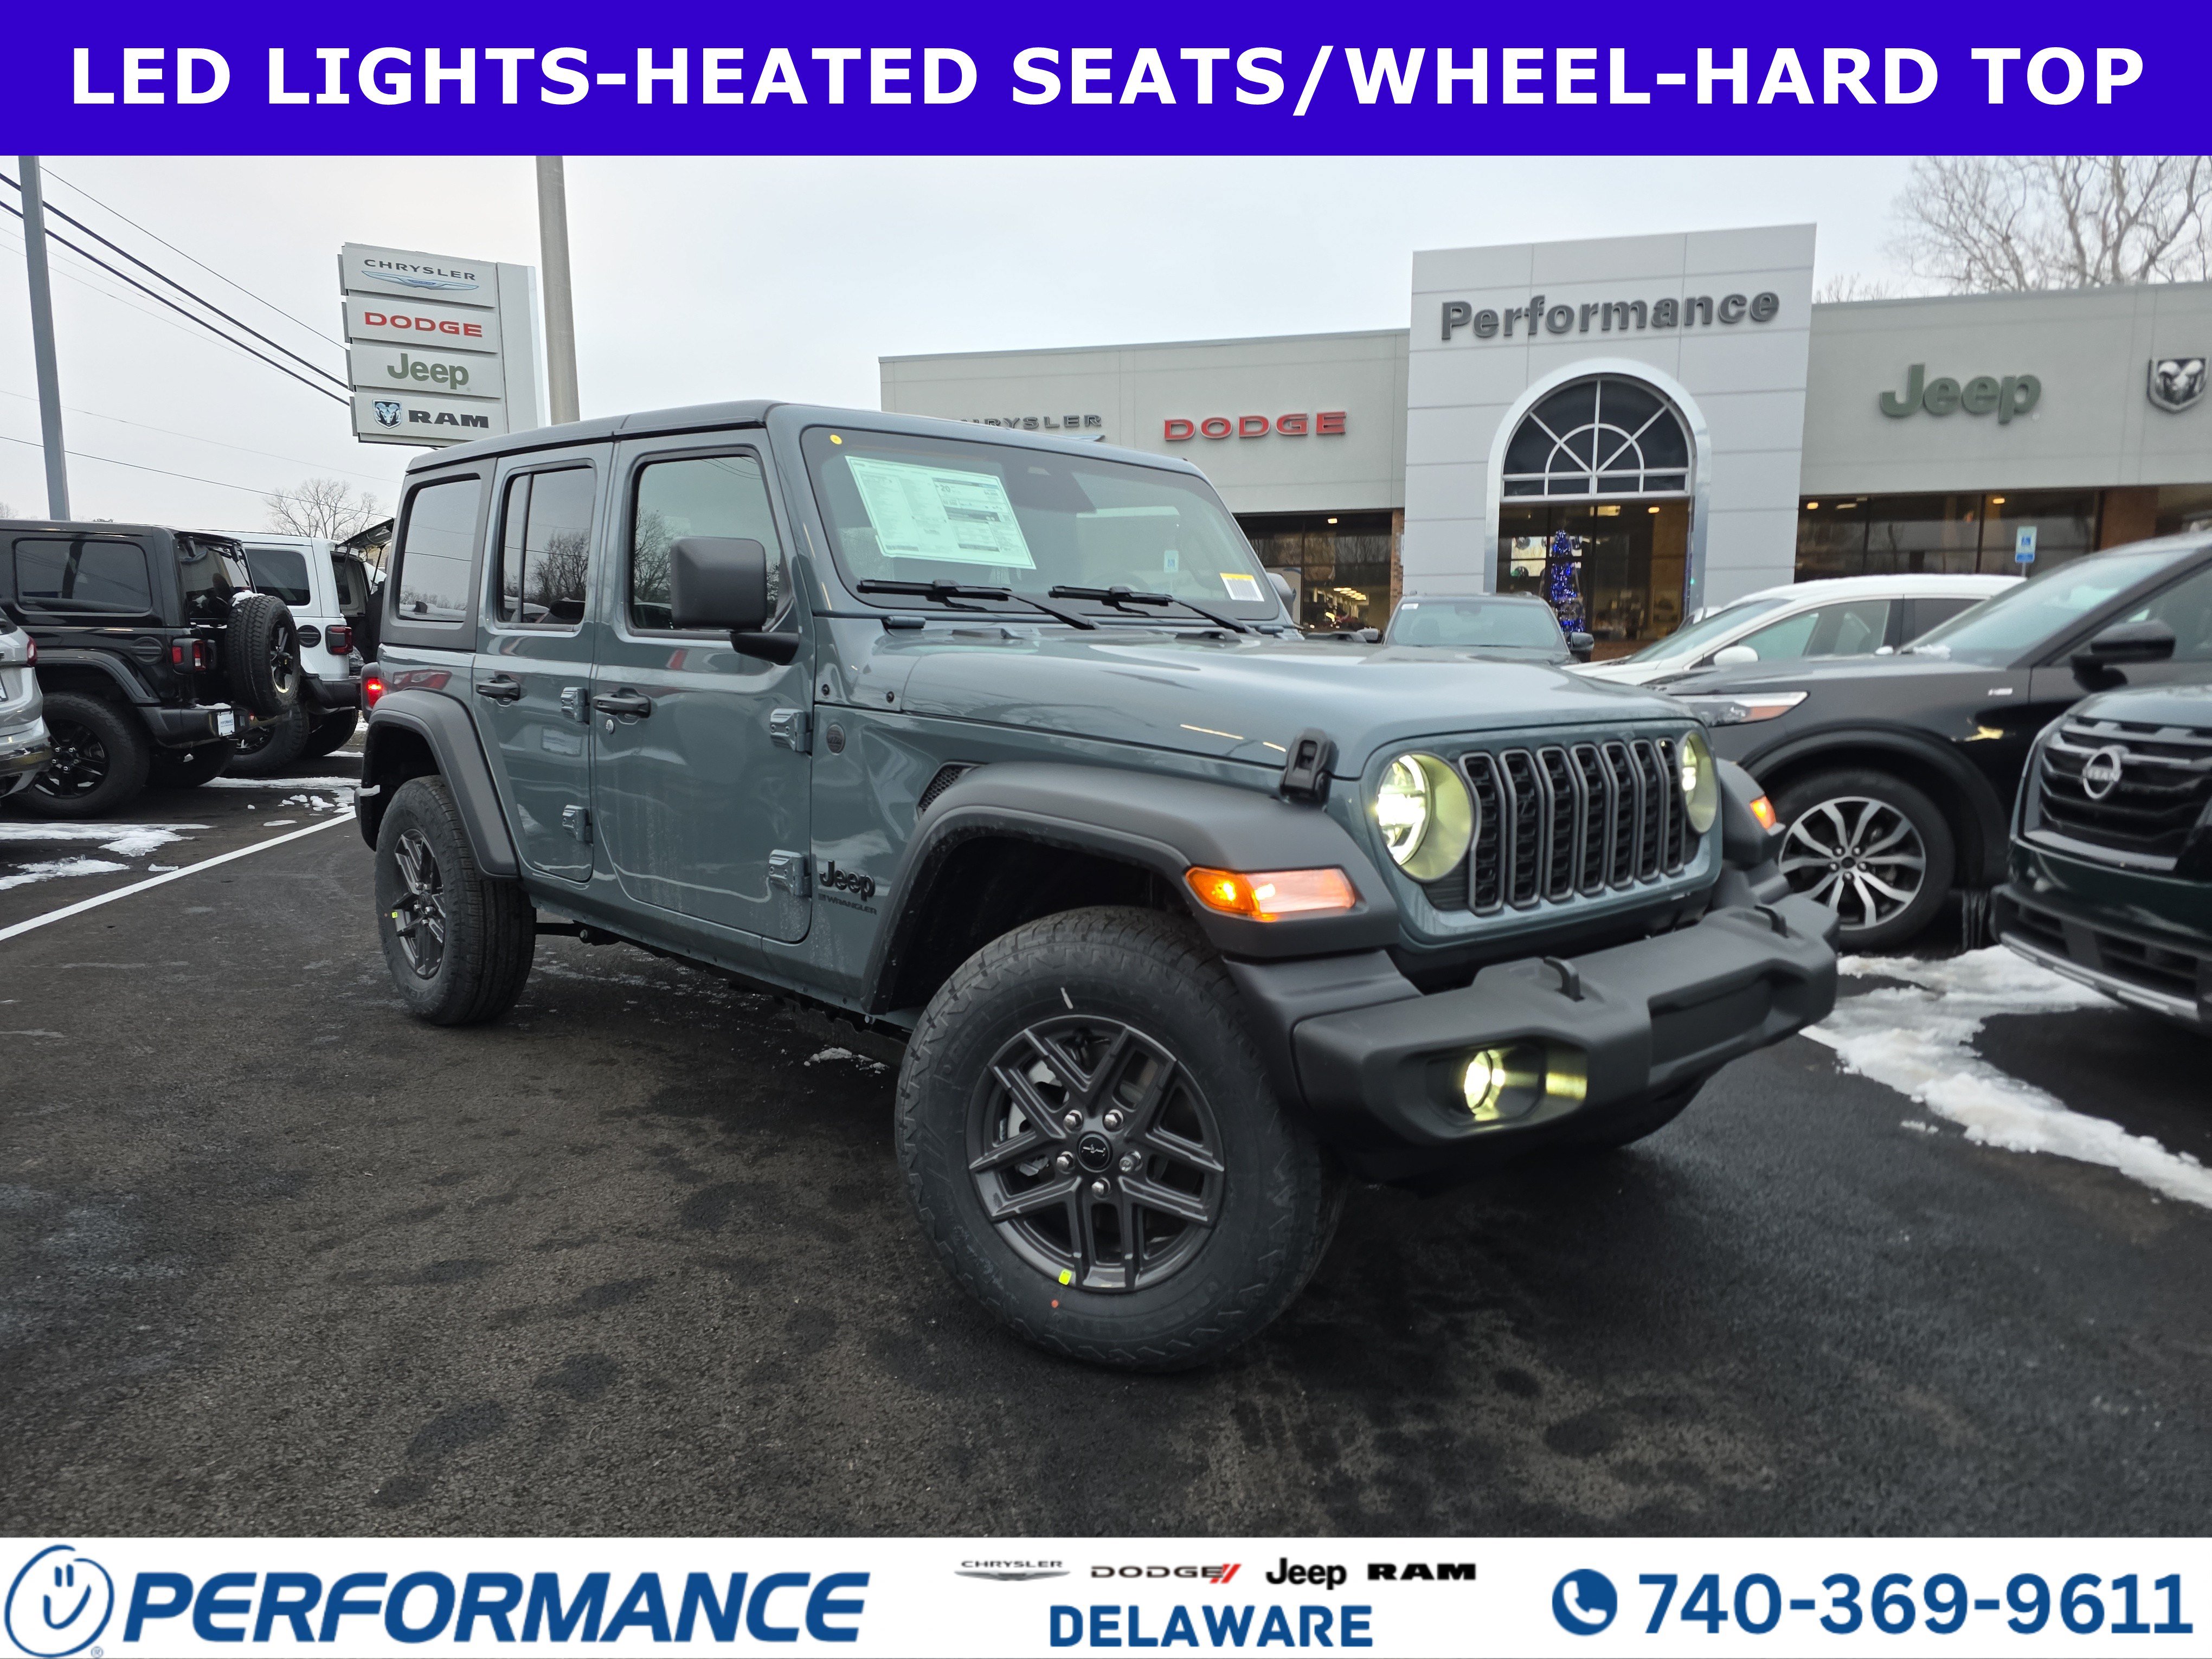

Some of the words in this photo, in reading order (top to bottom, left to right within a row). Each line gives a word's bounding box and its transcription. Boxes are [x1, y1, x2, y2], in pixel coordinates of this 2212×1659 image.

[364, 259, 475, 281] CHRYSLER
[364, 312, 483, 338] DODGE
[1441, 291, 1780, 340] Performance
[387, 353, 469, 390] Jeep
[1879, 363, 2042, 426] Jeep
[408, 409, 489, 428] RAM
[960, 414, 1102, 429] RYSLER
[1163, 411, 1347, 441] DODGE
[819, 860, 876, 902] Jeep
